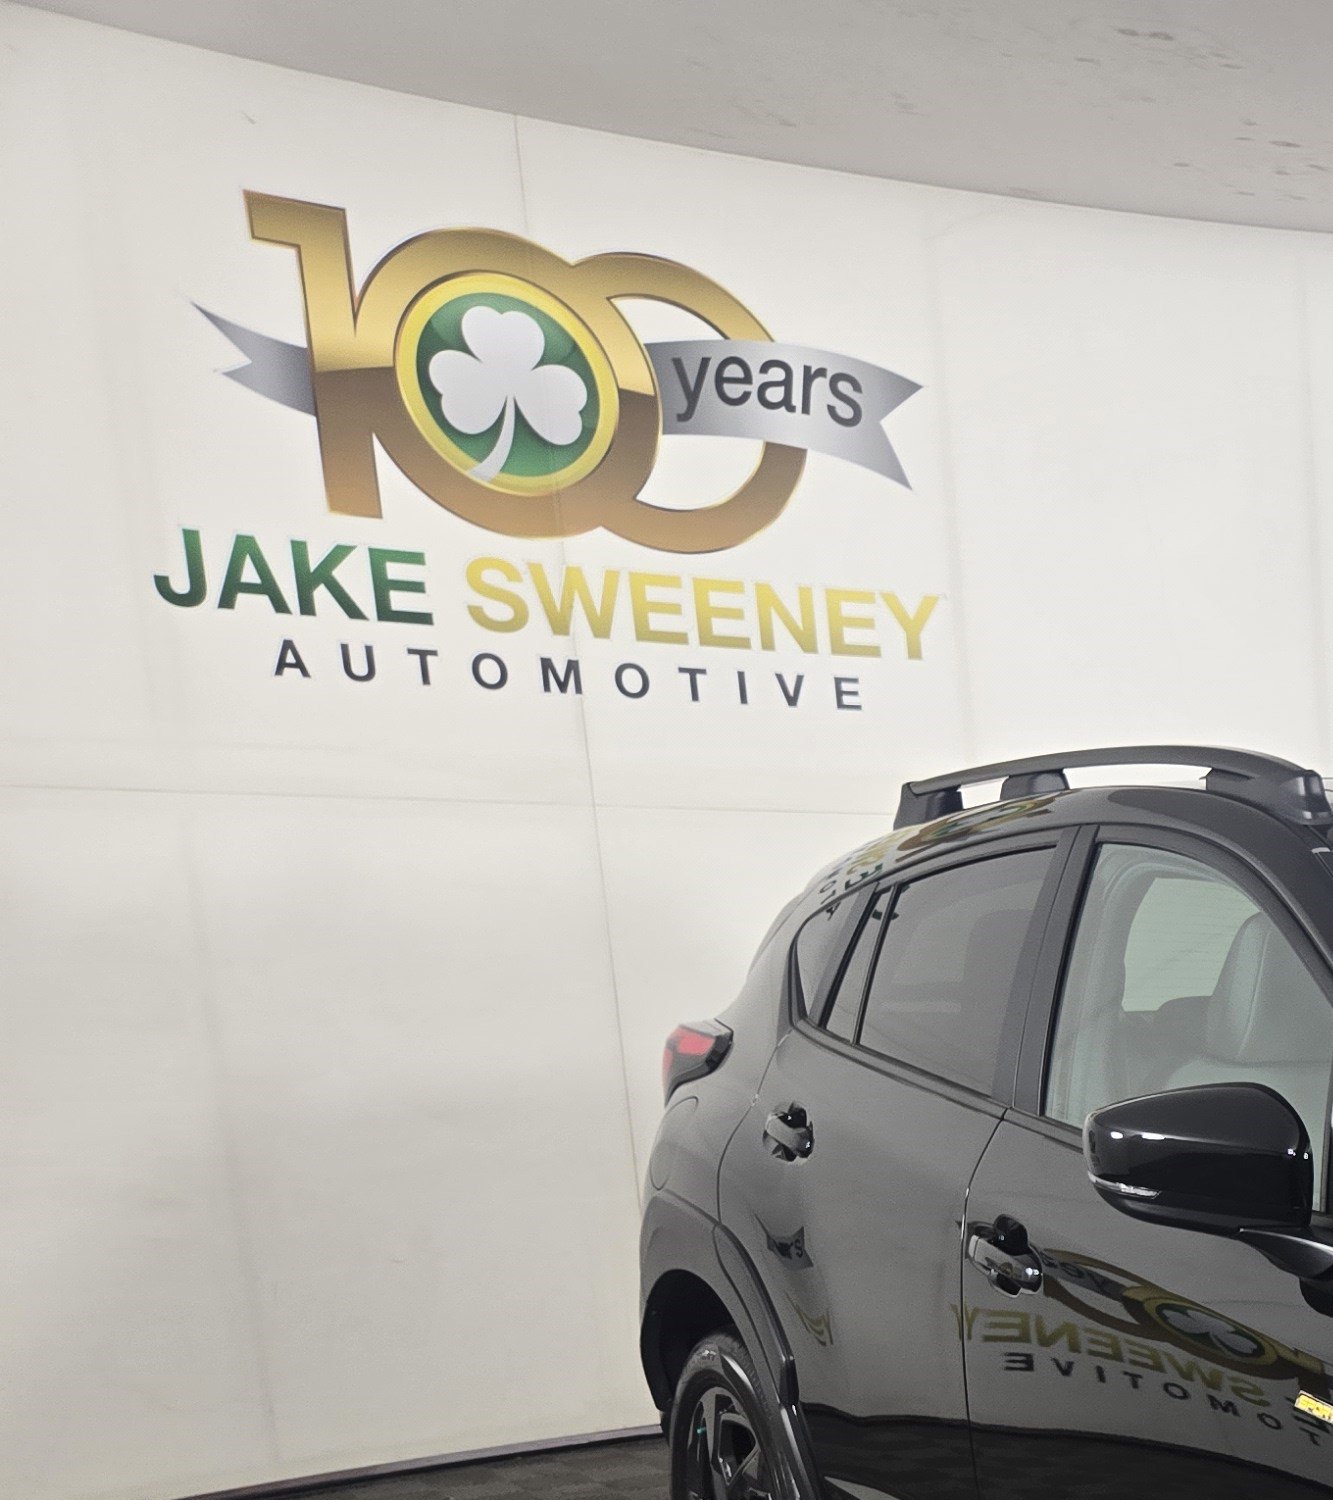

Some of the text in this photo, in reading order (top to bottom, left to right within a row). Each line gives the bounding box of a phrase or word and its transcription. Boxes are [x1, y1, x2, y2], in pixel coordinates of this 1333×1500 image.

[243, 189, 864, 554] 100 years
[153, 528, 941, 661] JAKE SWEENEY
[274, 638, 863, 711] AUTOMOTIVE
